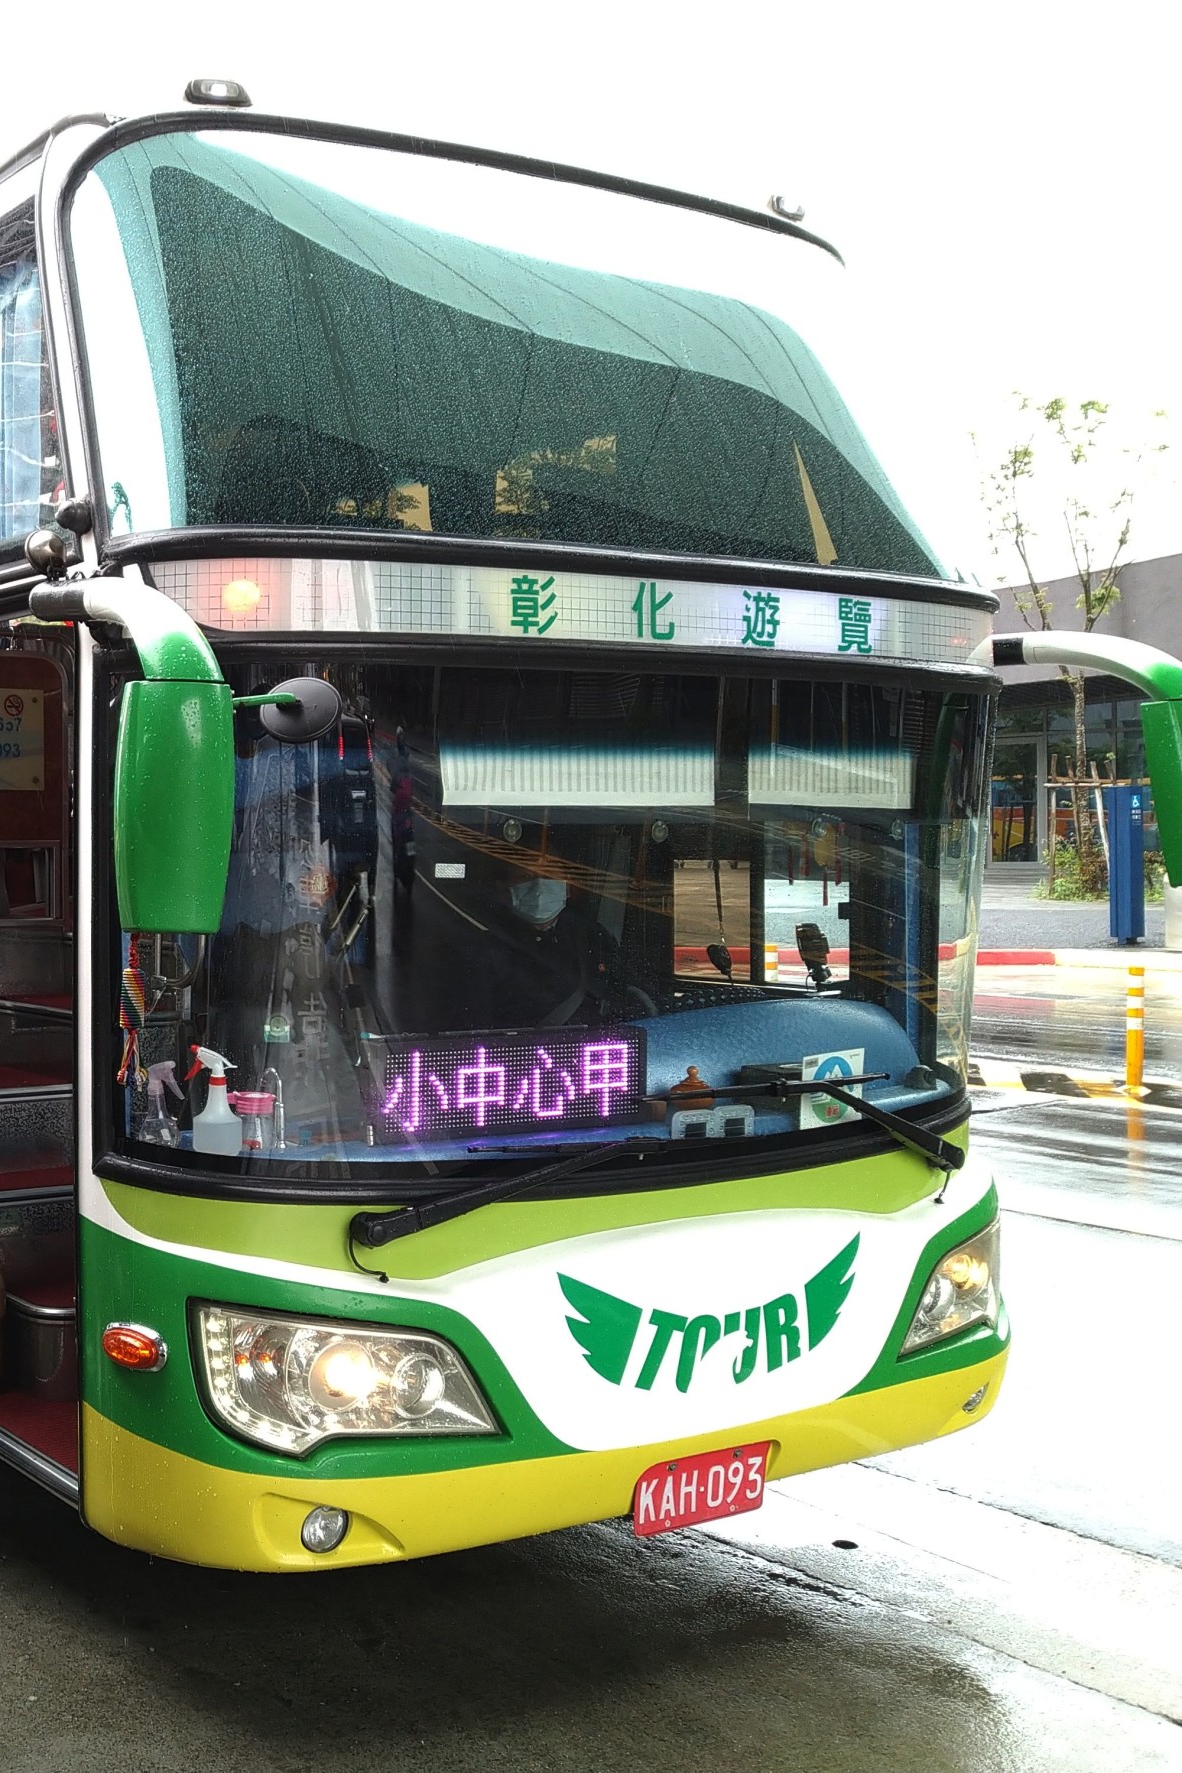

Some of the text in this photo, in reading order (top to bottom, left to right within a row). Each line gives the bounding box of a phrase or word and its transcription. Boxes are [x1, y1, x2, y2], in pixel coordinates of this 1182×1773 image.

[510, 574, 873, 654] 彰化遊覽
[381, 1042, 629, 1133] 小中心甲
